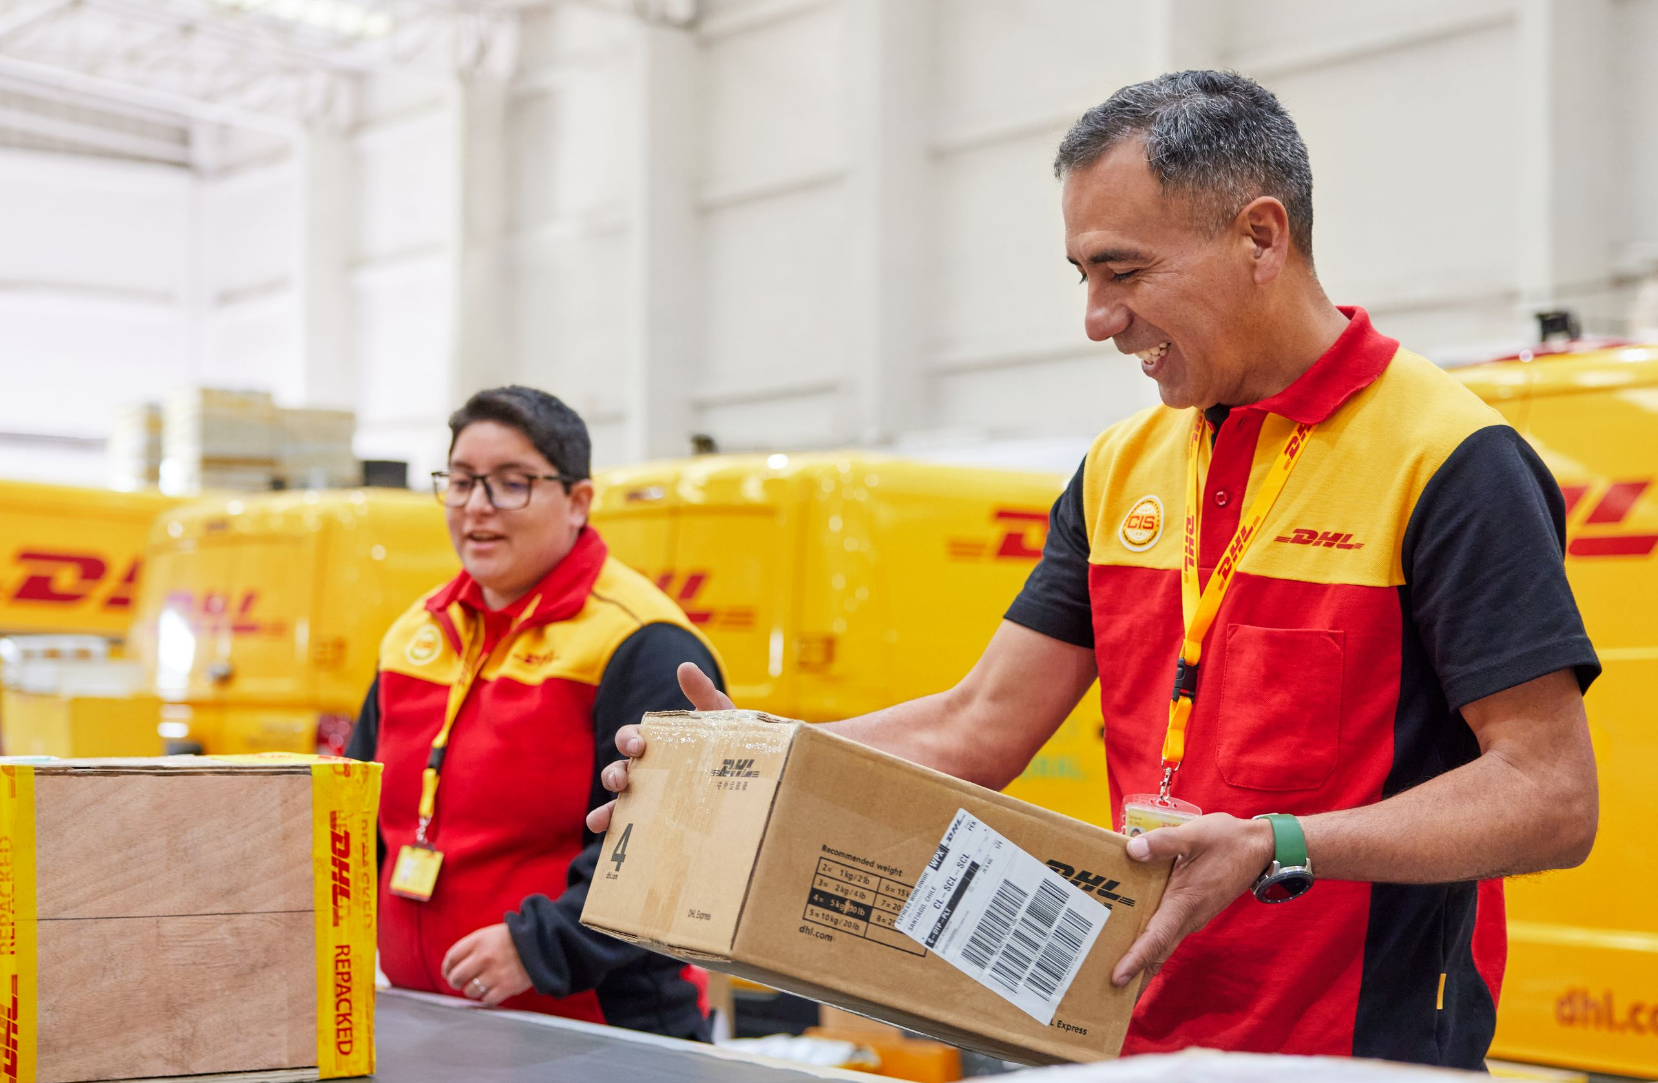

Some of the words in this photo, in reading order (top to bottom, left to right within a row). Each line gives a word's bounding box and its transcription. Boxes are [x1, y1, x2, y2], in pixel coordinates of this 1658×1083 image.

[1127, 515, 1155, 530] CIS
[1560, 483, 1658, 557] L
[1185, 514, 1195, 573] DHL
[1217, 524, 1255, 583] DHL
[1280, 528, 1362, 550] DHL
[611, 823, 633, 871] 4
[821, 845, 876, 867] Recommended
[876, 863, 903, 877] weight
[930, 847, 946, 869] WPX
[331, 830, 352, 909] DHL
[924, 886, 937, 904] CHILE
[799, 924, 834, 942] dhl.com
[335, 945, 353, 1056] REPACKED
[1057, 1020, 1088, 1035] Express
